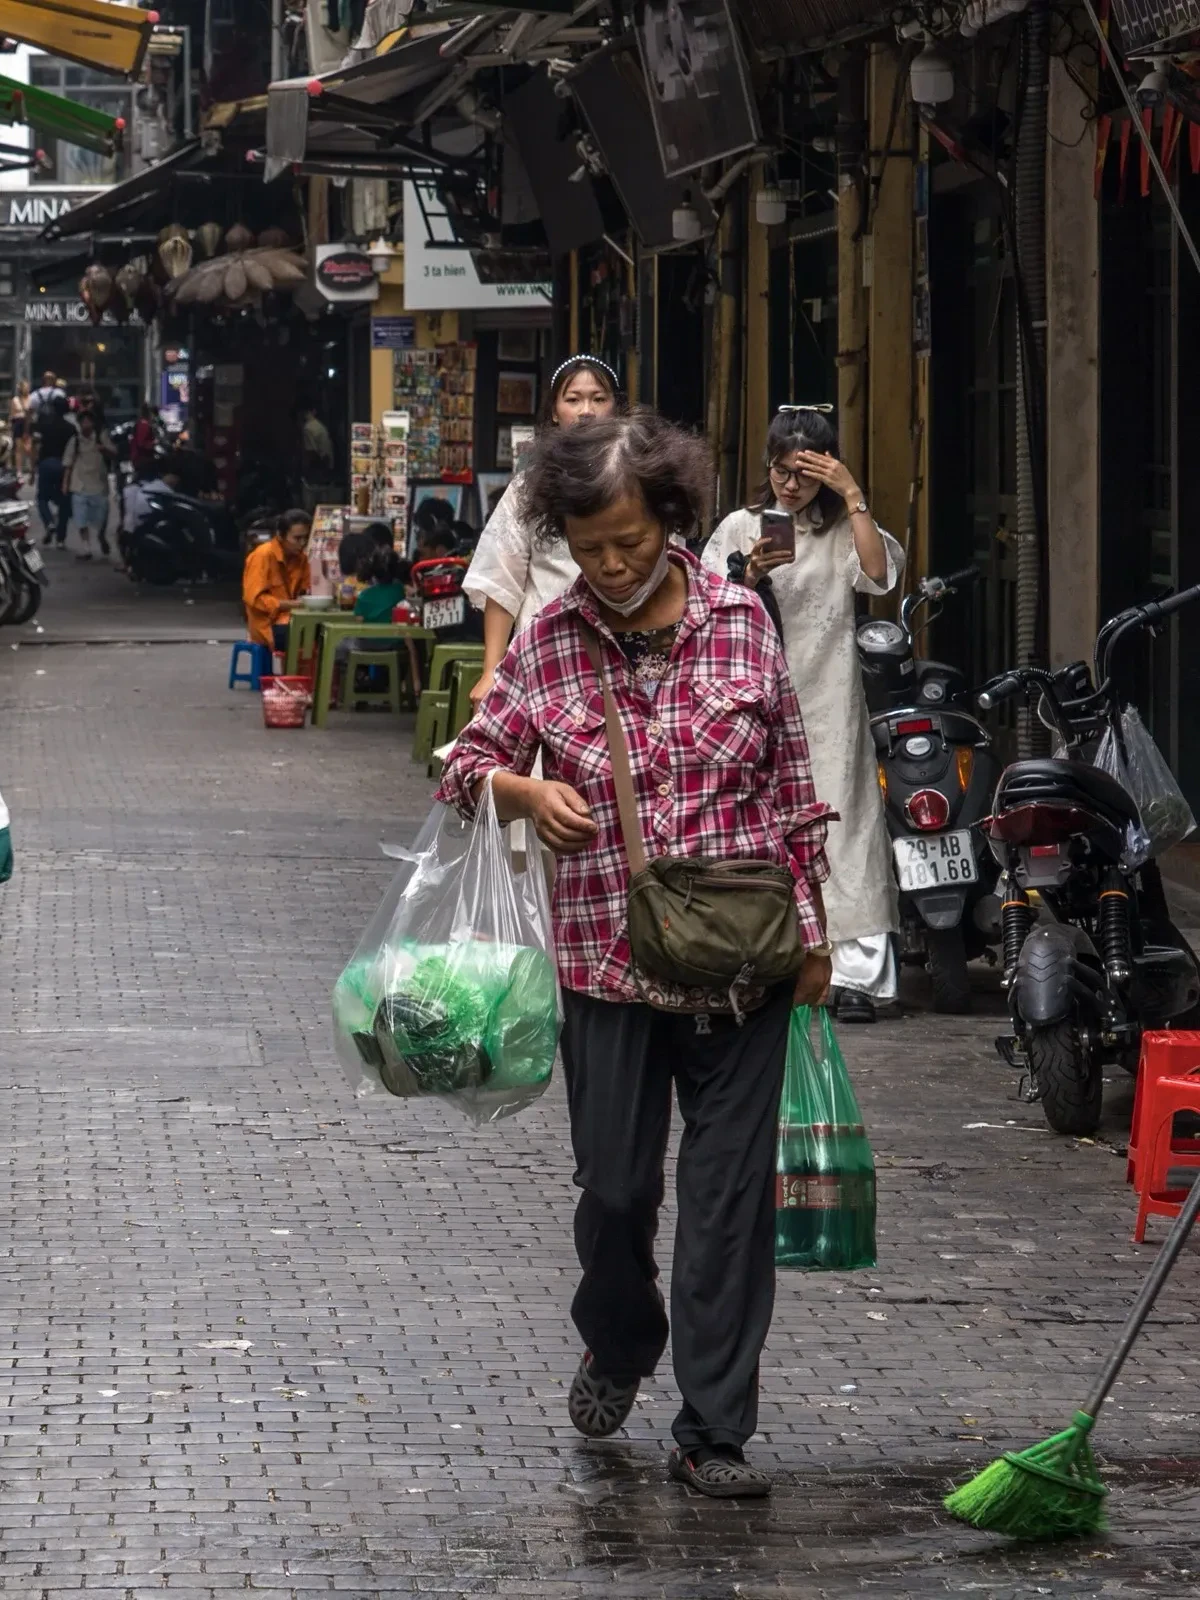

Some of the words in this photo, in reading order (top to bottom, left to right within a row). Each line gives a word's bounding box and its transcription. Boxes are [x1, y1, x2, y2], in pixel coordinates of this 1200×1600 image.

[10, 199, 71, 224] MINA
[424, 265, 430, 277] 3
[444, 263, 466, 277] hien
[24, 303, 63, 322] MINA
[905, 835, 961, 862] 29-AB
[903, 858, 971, 886] 181.68
